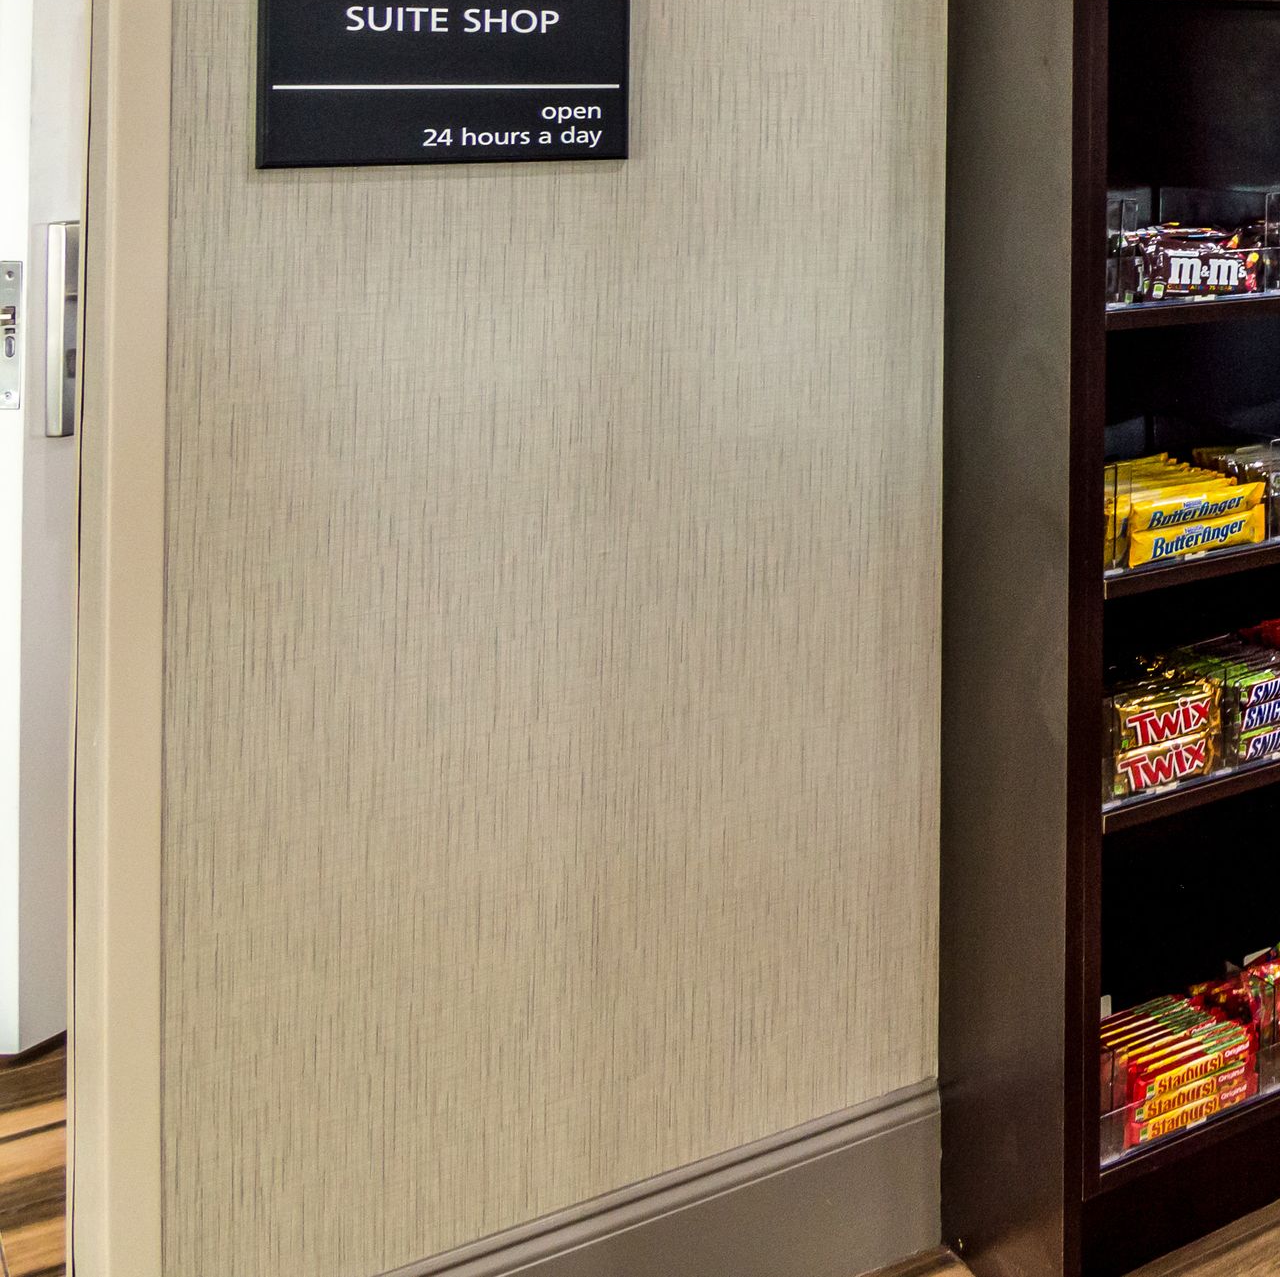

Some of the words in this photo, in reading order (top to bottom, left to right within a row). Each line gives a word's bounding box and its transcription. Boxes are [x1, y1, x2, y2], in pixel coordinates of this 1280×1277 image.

[345, 5, 450, 33] SUITE
[463, 8, 560, 34] SHOP
[541, 105, 602, 124] open
[422, 128, 453, 147] 24
[462, 127, 531, 146] hours
[538, 132, 552, 145] a
[560, 125, 603, 148] day
[1149, 495, 1244, 529] Butterfinger
[1151, 519, 1246, 559] Butterfinger
[1158, 1054, 1224, 1095] Starburst
[1224, 1041, 1250, 1058] Original
[1147, 1077, 1217, 1118] Starburst
[1151, 1097, 1220, 1138] Starburst
[1220, 1084, 1248, 1100] Original
